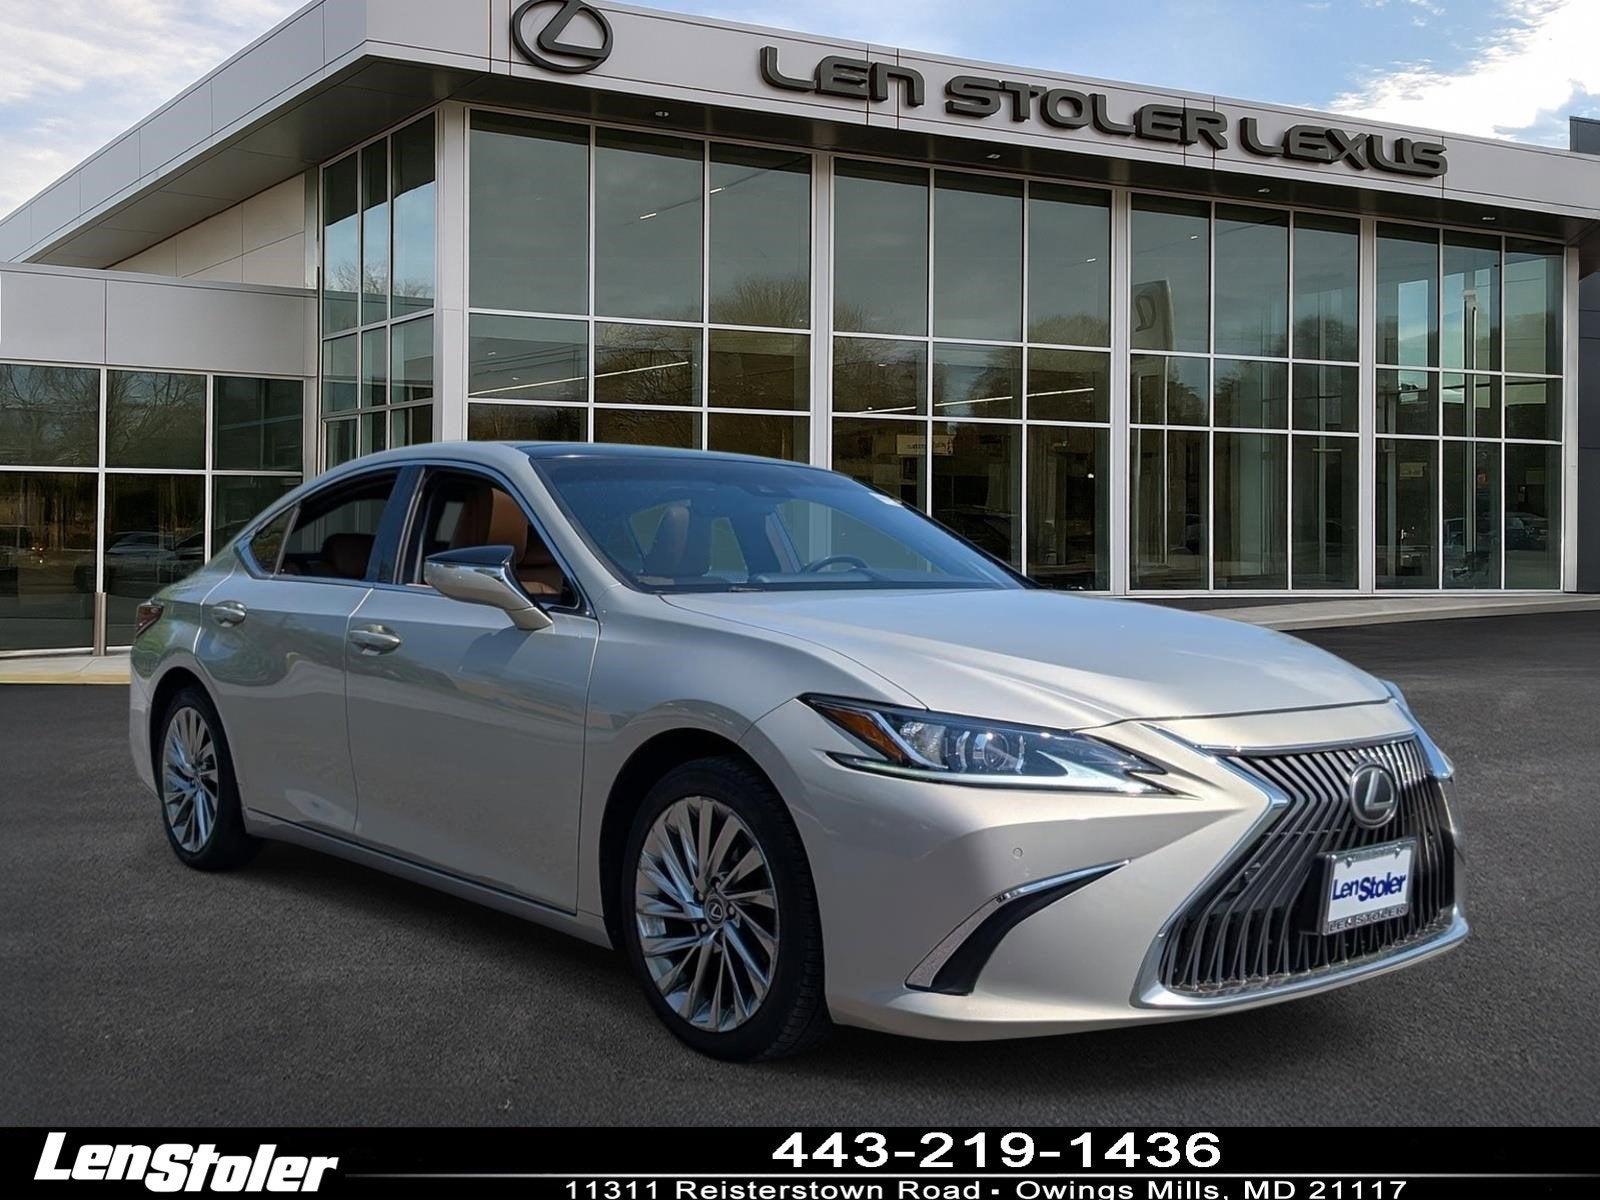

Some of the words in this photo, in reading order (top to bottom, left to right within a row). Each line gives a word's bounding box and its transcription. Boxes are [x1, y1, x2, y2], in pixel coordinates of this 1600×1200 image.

[945, 74, 1227, 150] STOLER
[1239, 117, 1448, 177] LEXUS
[1332, 872, 1407, 902] LenStoler
